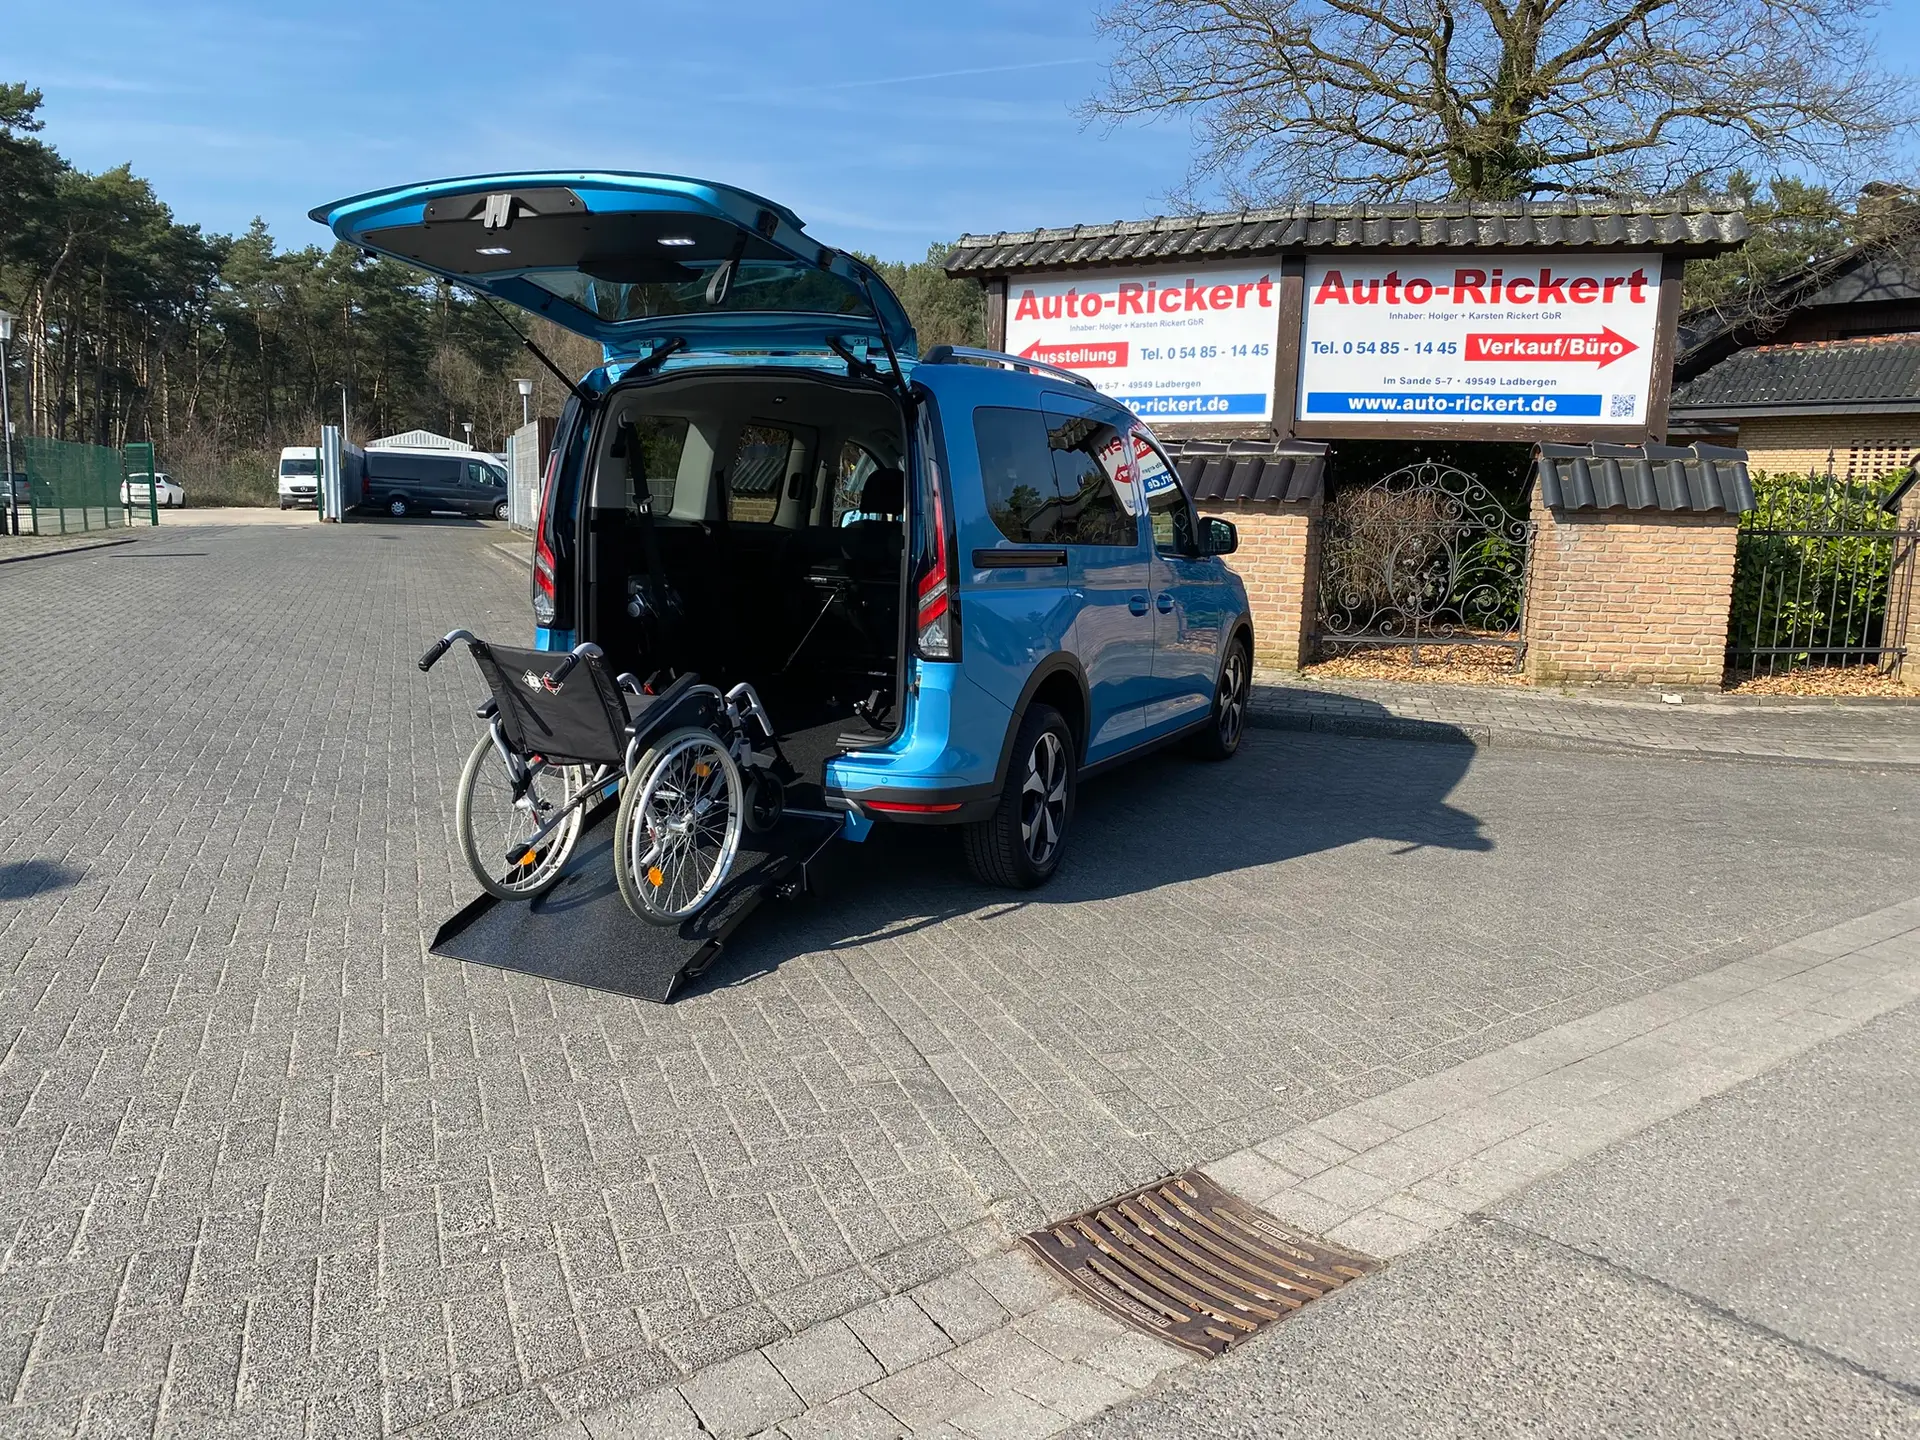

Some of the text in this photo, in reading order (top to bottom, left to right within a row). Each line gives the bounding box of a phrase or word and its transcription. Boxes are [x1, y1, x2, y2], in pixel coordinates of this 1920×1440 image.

[1313, 267, 1648, 306] Auto-Rickert
[1014, 272, 1273, 321] Auto-Rickert
[1389, 312, 1426, 320] Inhaber:
[1428, 312, 1459, 321] Holger
[1468, 312, 1504, 320] Karsten
[1506, 312, 1539, 320] Rickert
[1541, 311, 1562, 320] GbR
[1069, 324, 1098, 333] Inhaber:
[1099, 322, 1122, 332] Holger
[1130, 320, 1158, 329] Karsten
[1159, 319, 1186, 327] Rickert
[1187, 318, 1204, 326] GbR
[1140, 347, 1163, 360] Tel.
[1167, 347, 1176, 360] 0
[1179, 346, 1196, 359] 54
[1200, 345, 1217, 358] 85
[1231, 344, 1247, 357] 14
[1251, 343, 1269, 356] 45
[1311, 341, 1338, 354] Tel.
[1343, 341, 1353, 354] 0
[1356, 341, 1376, 354] 54
[1380, 341, 1400, 354] 85
[1414, 341, 1433, 354] 14
[1437, 341, 1457, 354] 45
[1478, 338, 1623, 356] Verkauf/Büro
[1031, 348, 1117, 364] Ausstellung
[1128, 380, 1153, 389] 49549
[1155, 380, 1201, 389] Ladbergen
[1383, 377, 1396, 385] Im
[1399, 377, 1432, 385] Sande
[1465, 377, 1497, 386] 49549
[1500, 377, 1557, 388] Ladbergen
[1123, 396, 1229, 413] to-rickert.de
[1348, 395, 1557, 412] www.auto-rickert.de
